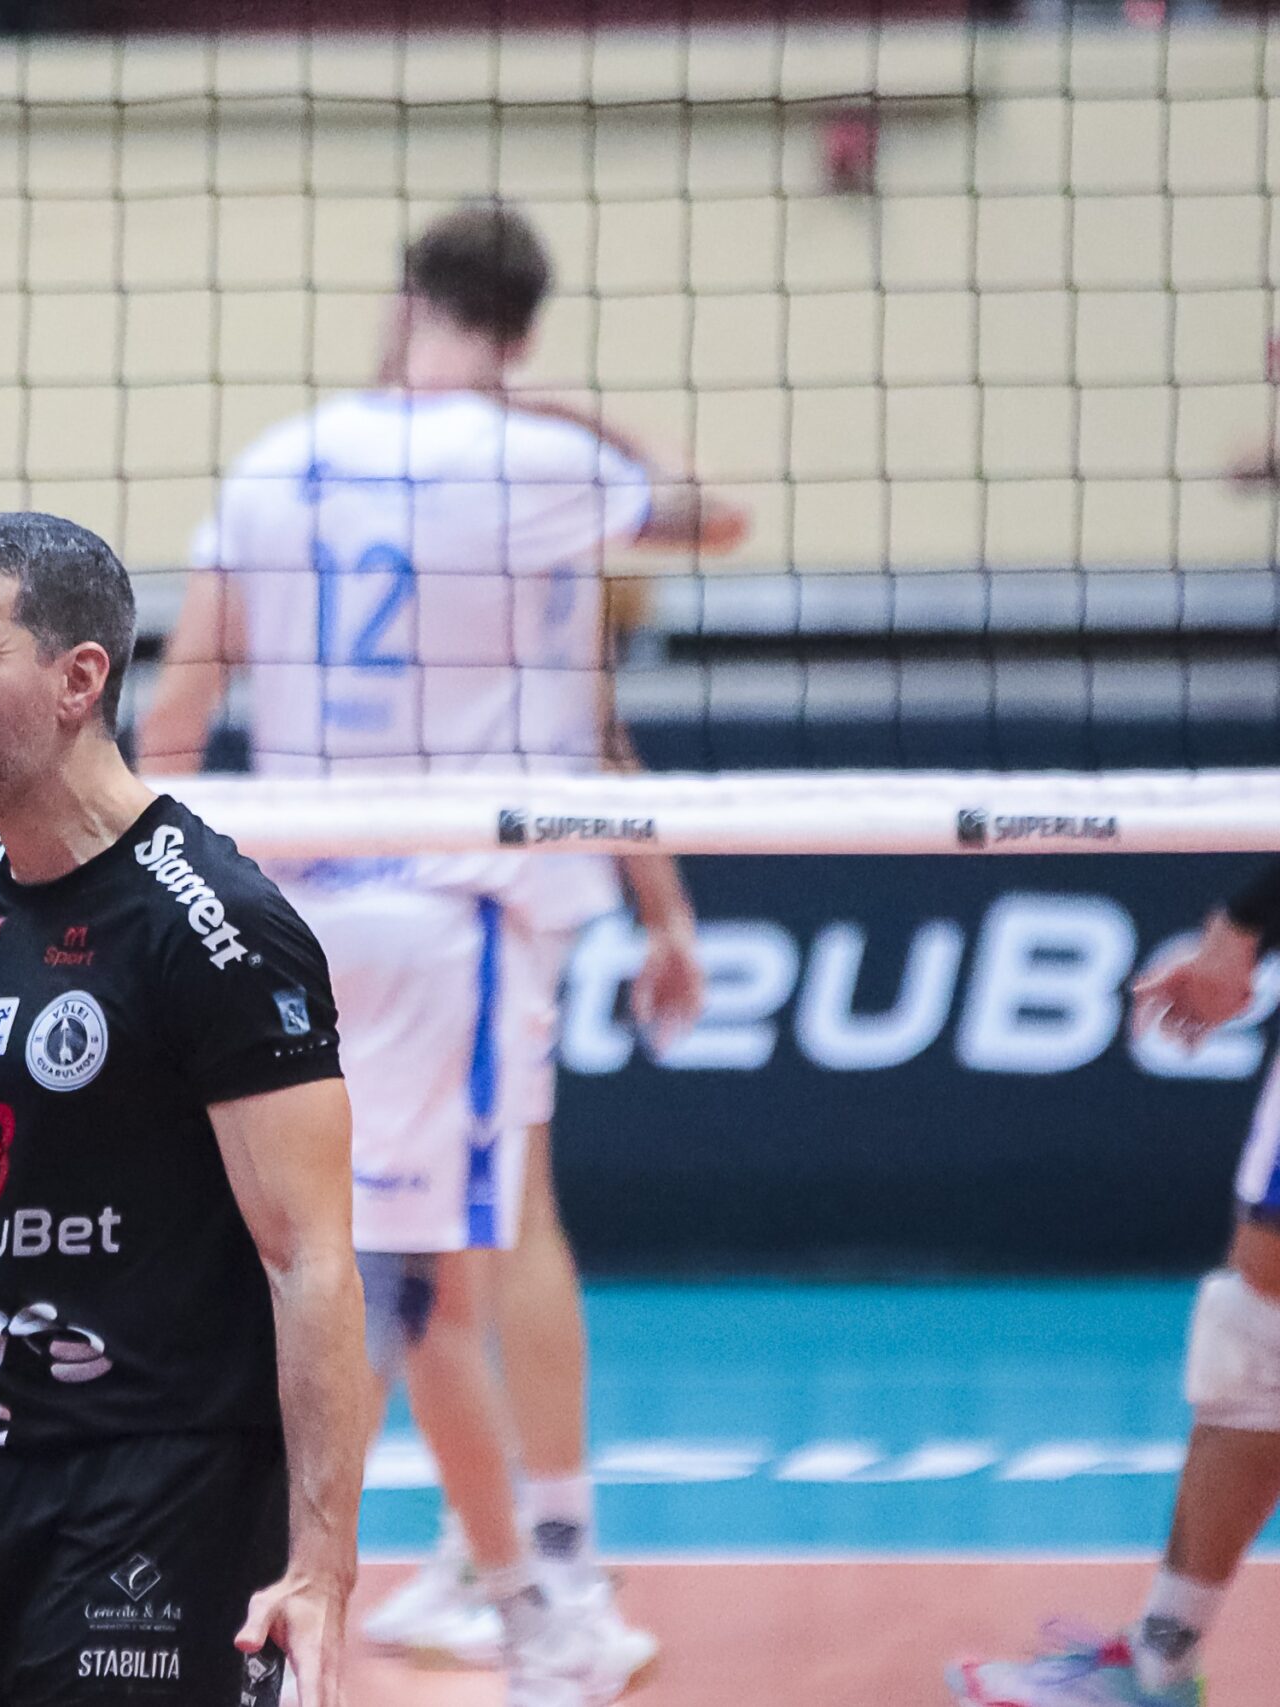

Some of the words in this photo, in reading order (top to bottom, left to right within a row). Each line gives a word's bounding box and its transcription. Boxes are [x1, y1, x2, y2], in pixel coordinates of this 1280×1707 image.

[310, 540, 418, 675] 12
[536, 816, 657, 843] SUPERLIGA
[995, 815, 1117, 842] SUPERLIGA
[134, 824, 249, 970] Starrett
